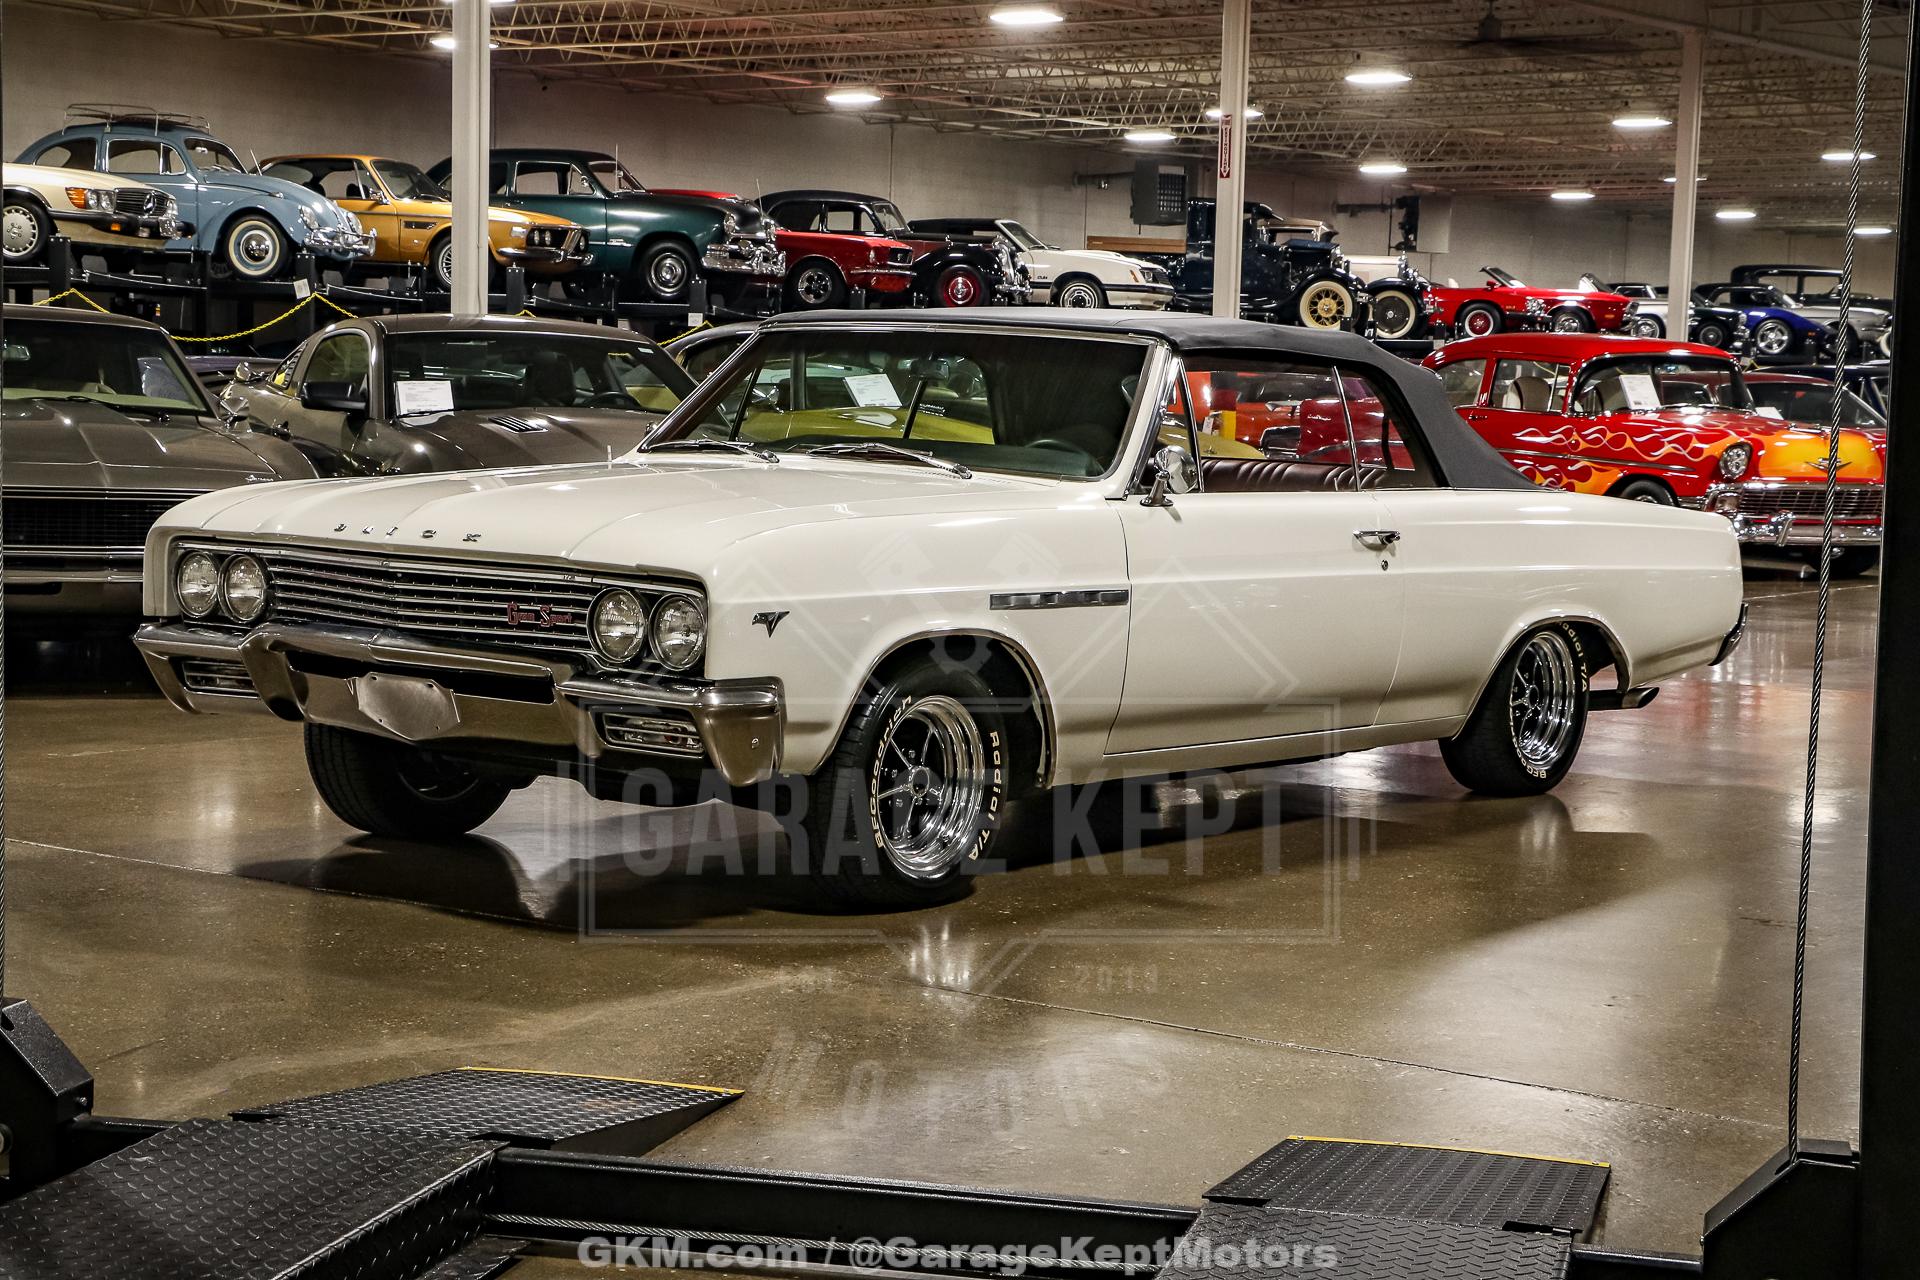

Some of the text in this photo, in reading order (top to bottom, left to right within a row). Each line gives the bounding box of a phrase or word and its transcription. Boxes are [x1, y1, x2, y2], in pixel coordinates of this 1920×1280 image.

[333, 523, 482, 543] BUICK
[507, 602, 573, 627] Gran Sport
[1560, 622, 1588, 692] adial T/A
[869, 695, 912, 849] BFGoodrich
[968, 731, 1002, 861] Radial T/A
